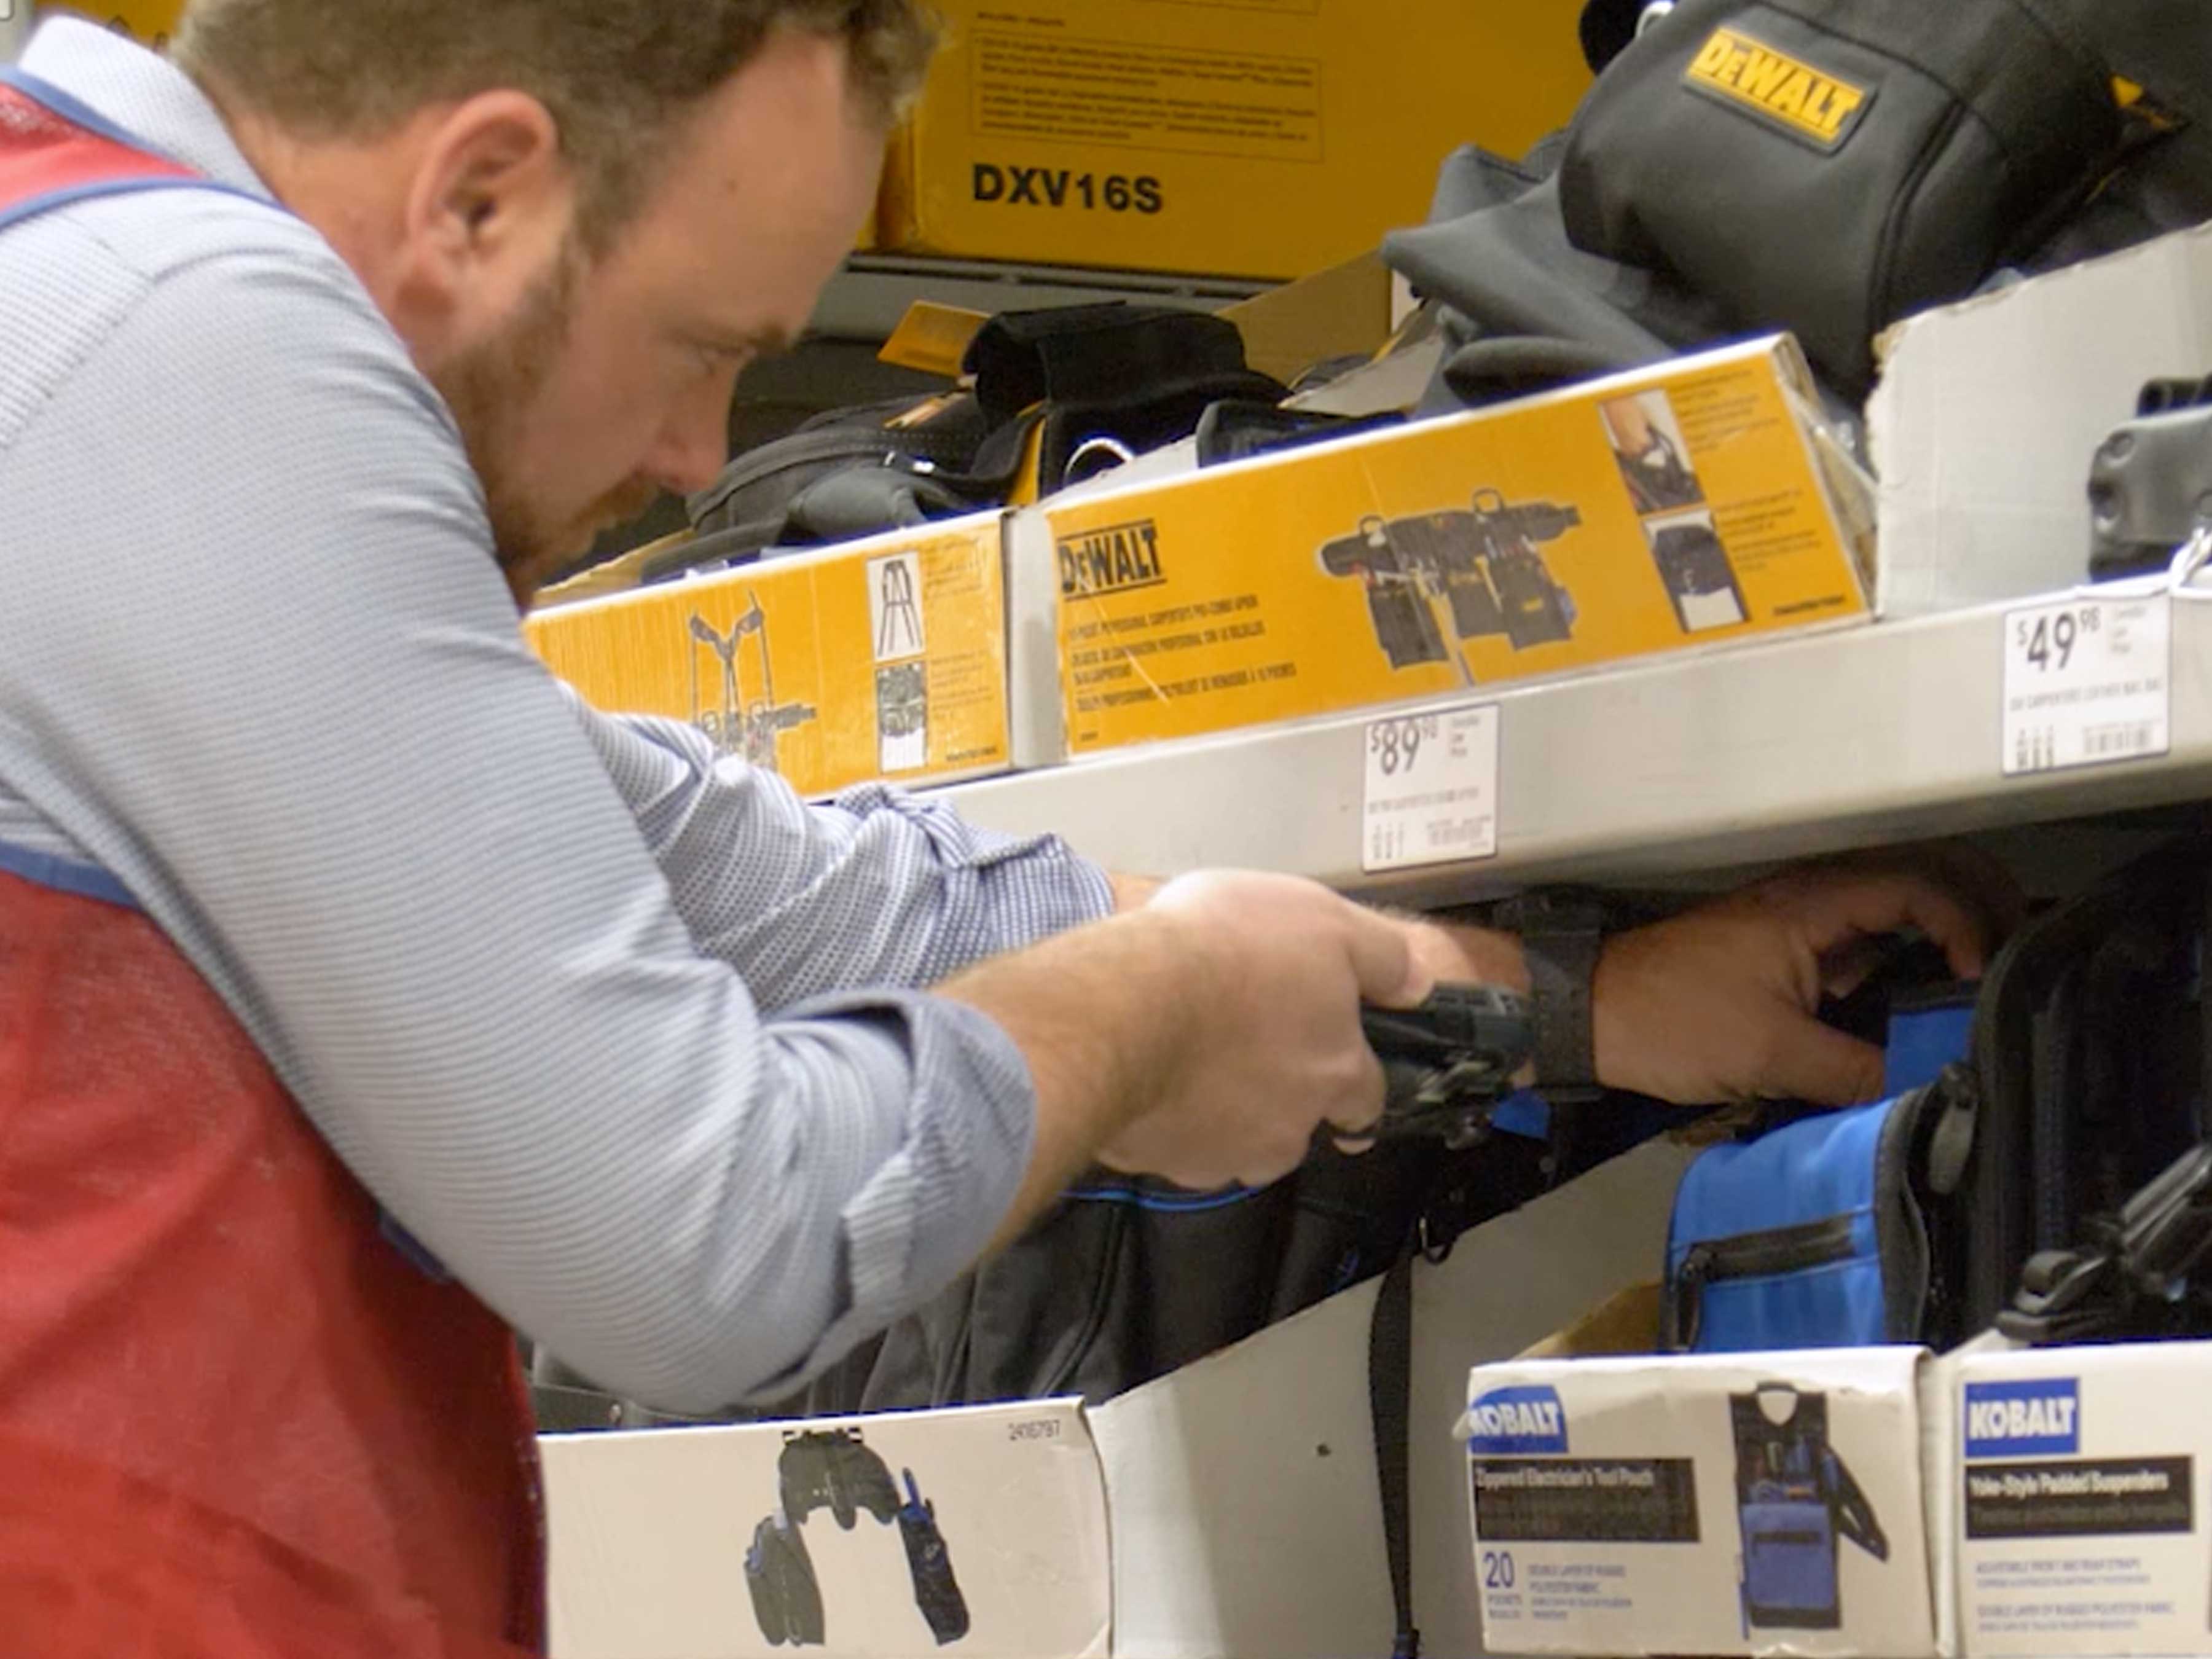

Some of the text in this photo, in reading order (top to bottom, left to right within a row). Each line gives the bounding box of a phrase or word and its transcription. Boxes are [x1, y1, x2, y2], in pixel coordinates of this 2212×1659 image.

[973, 163, 1163, 214] DXV16S
[1969, 1397, 2076, 1439] KOBALT
[1483, 1551, 1515, 1588] 20
